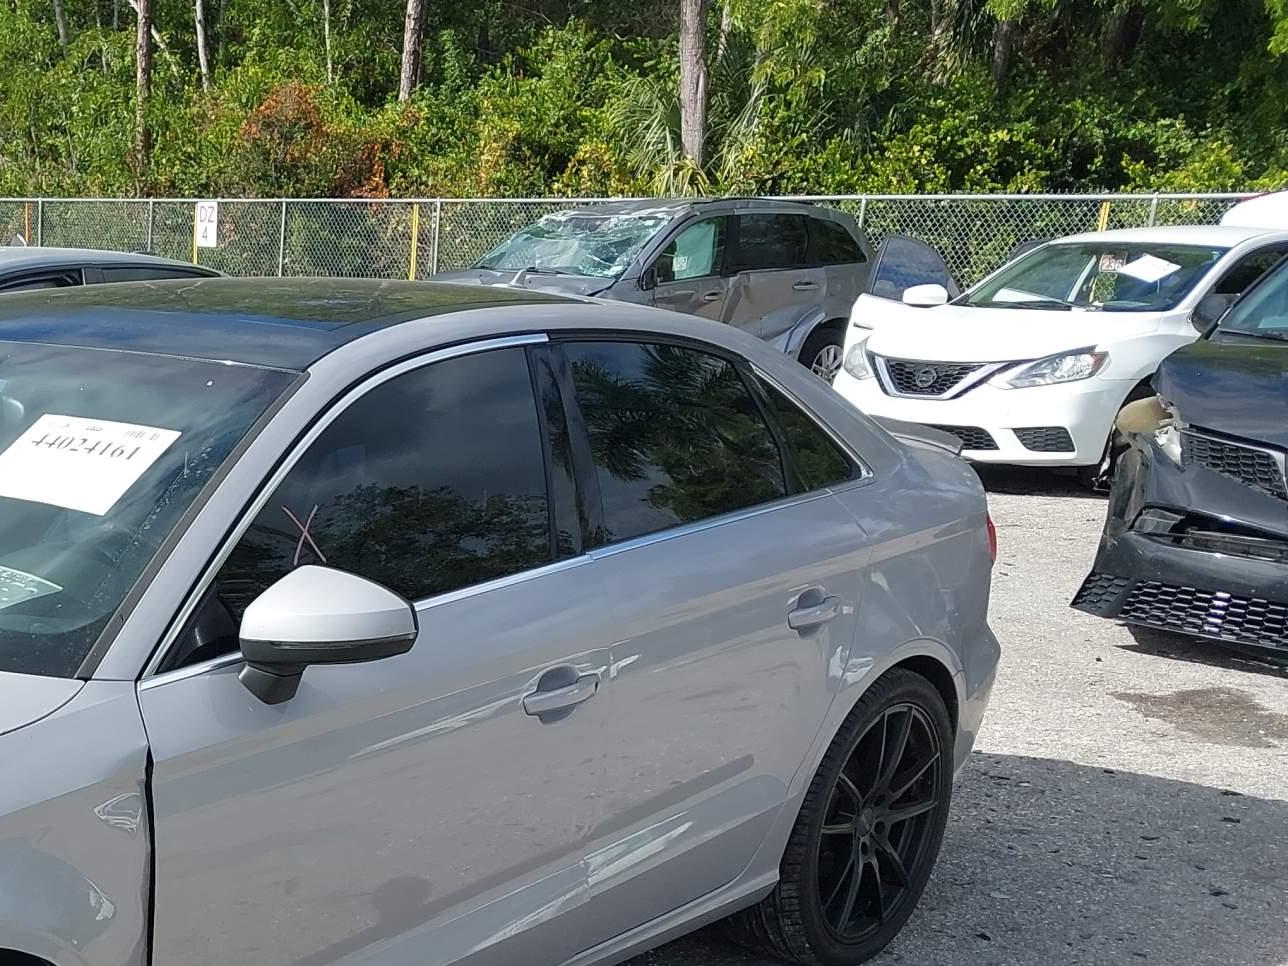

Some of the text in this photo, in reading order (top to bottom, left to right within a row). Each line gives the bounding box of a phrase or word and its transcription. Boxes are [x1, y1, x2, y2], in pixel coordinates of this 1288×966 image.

[199, 205, 215, 223] DZ
[202, 225, 208, 241] 4
[32, 434, 142, 460] 44024161
